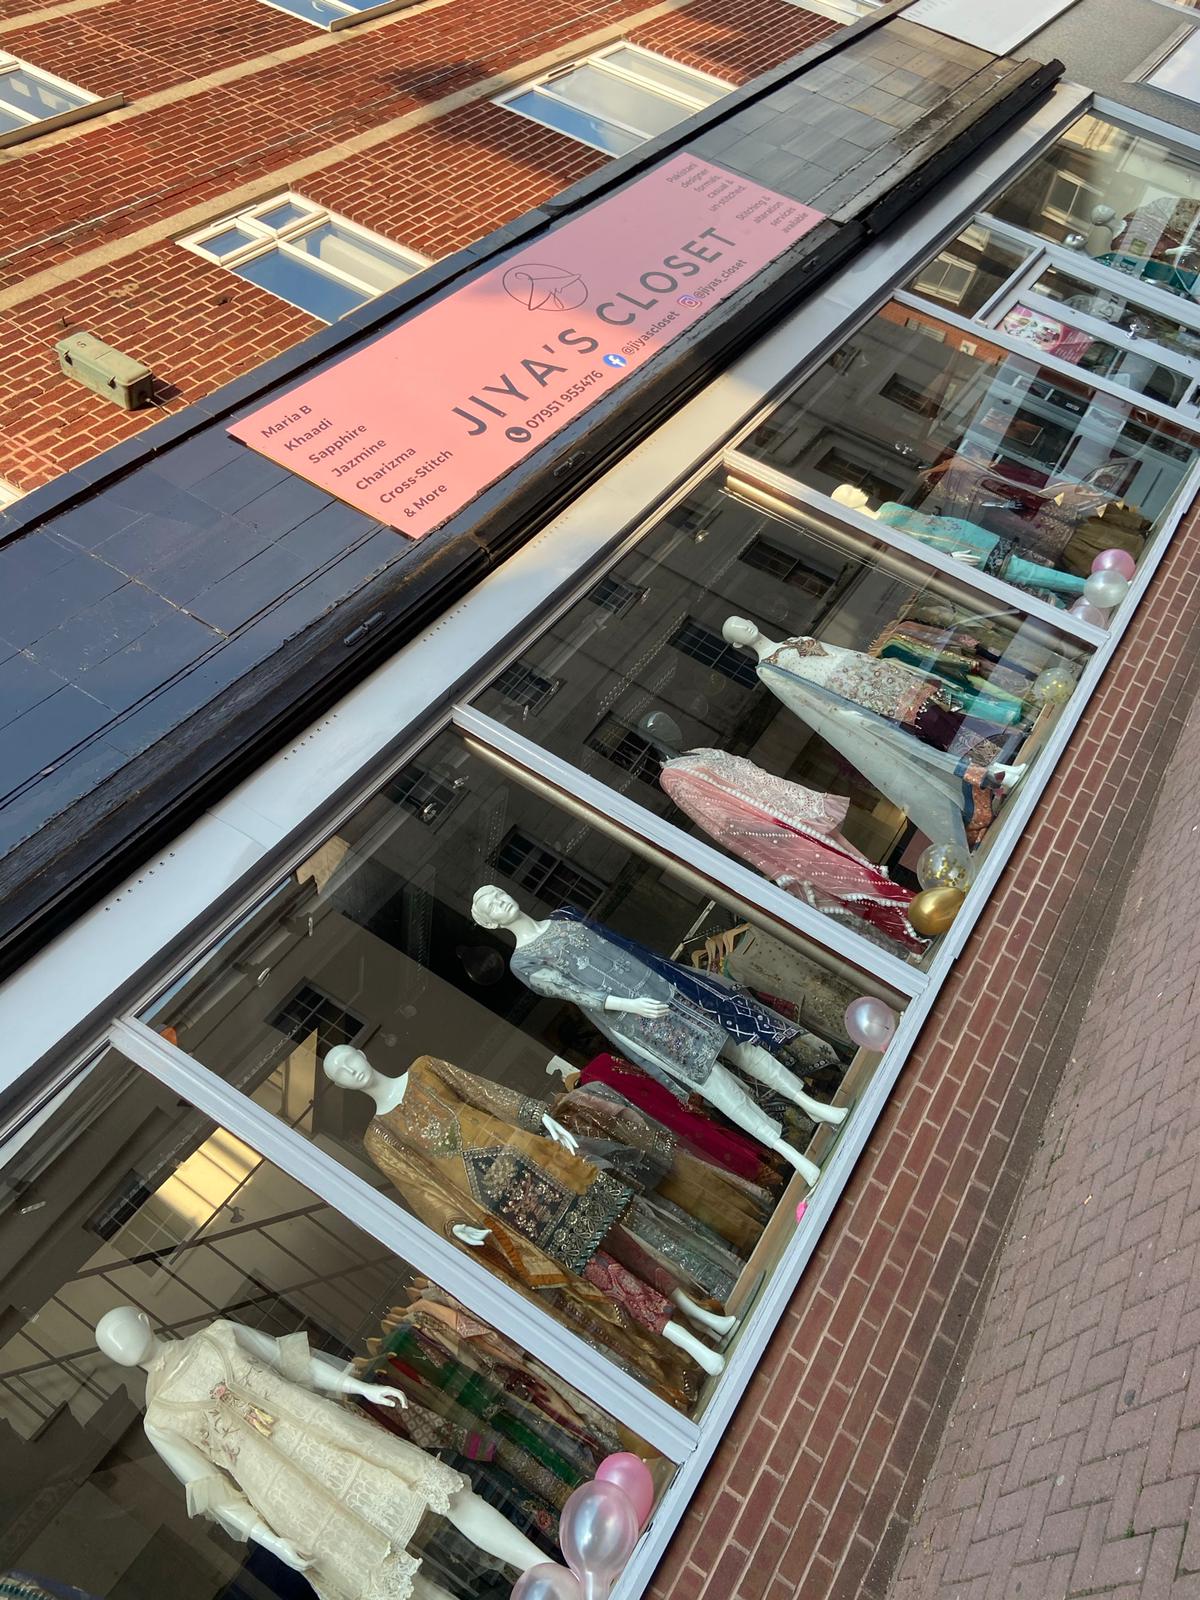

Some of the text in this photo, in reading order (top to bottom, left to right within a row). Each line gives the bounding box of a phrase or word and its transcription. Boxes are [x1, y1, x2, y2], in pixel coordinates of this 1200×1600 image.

[707, 182, 729, 199] casual
[735, 198, 767, 222] Stitching
[753, 201, 784, 224] alteration
[770, 207, 796, 227] services
[782, 212, 809, 234] available
[693, 258, 748, 301] @jiyas_closet
[451, 227, 737, 436] JIYA'S CLOSET
[621, 310, 681, 356] @jiyascloset
[525, 369, 604, 430] 07951 955476
[261, 404, 312, 439] Maria B
[283, 417, 333, 452] Khaadi
[308, 423, 368, 465] Sapphire
[331, 438, 387, 478] Jazmine
[355, 446, 416, 490] Charizma
[379, 448, 454, 504] Cross-Stitch
[403, 483, 448, 518] & More
